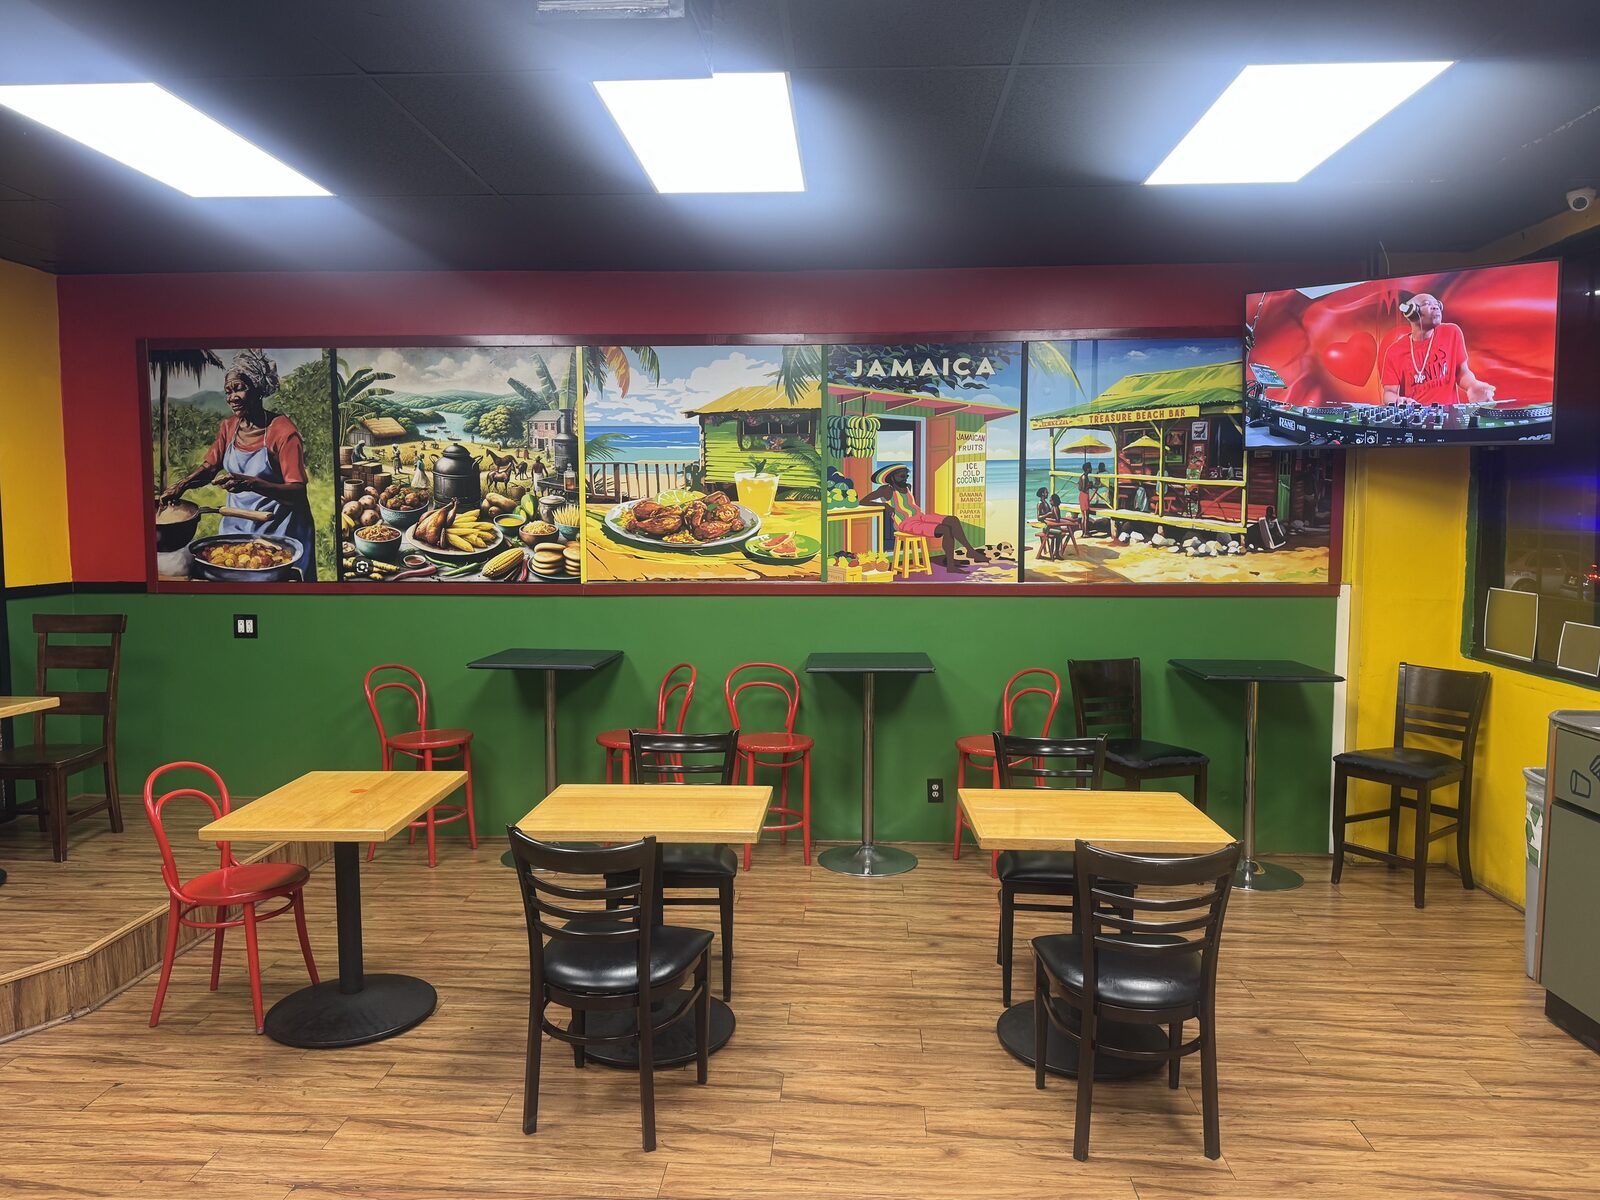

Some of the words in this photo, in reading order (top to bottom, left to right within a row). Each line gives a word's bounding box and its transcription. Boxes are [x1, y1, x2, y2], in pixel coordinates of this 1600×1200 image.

[851, 357, 995, 377] JAMAICA
[1089, 412, 1132, 424] TREASURE
[1136, 410, 1165, 420] BEACH
[1169, 408, 1186, 418] BAR
[956, 433, 985, 441] JAMAICAN
